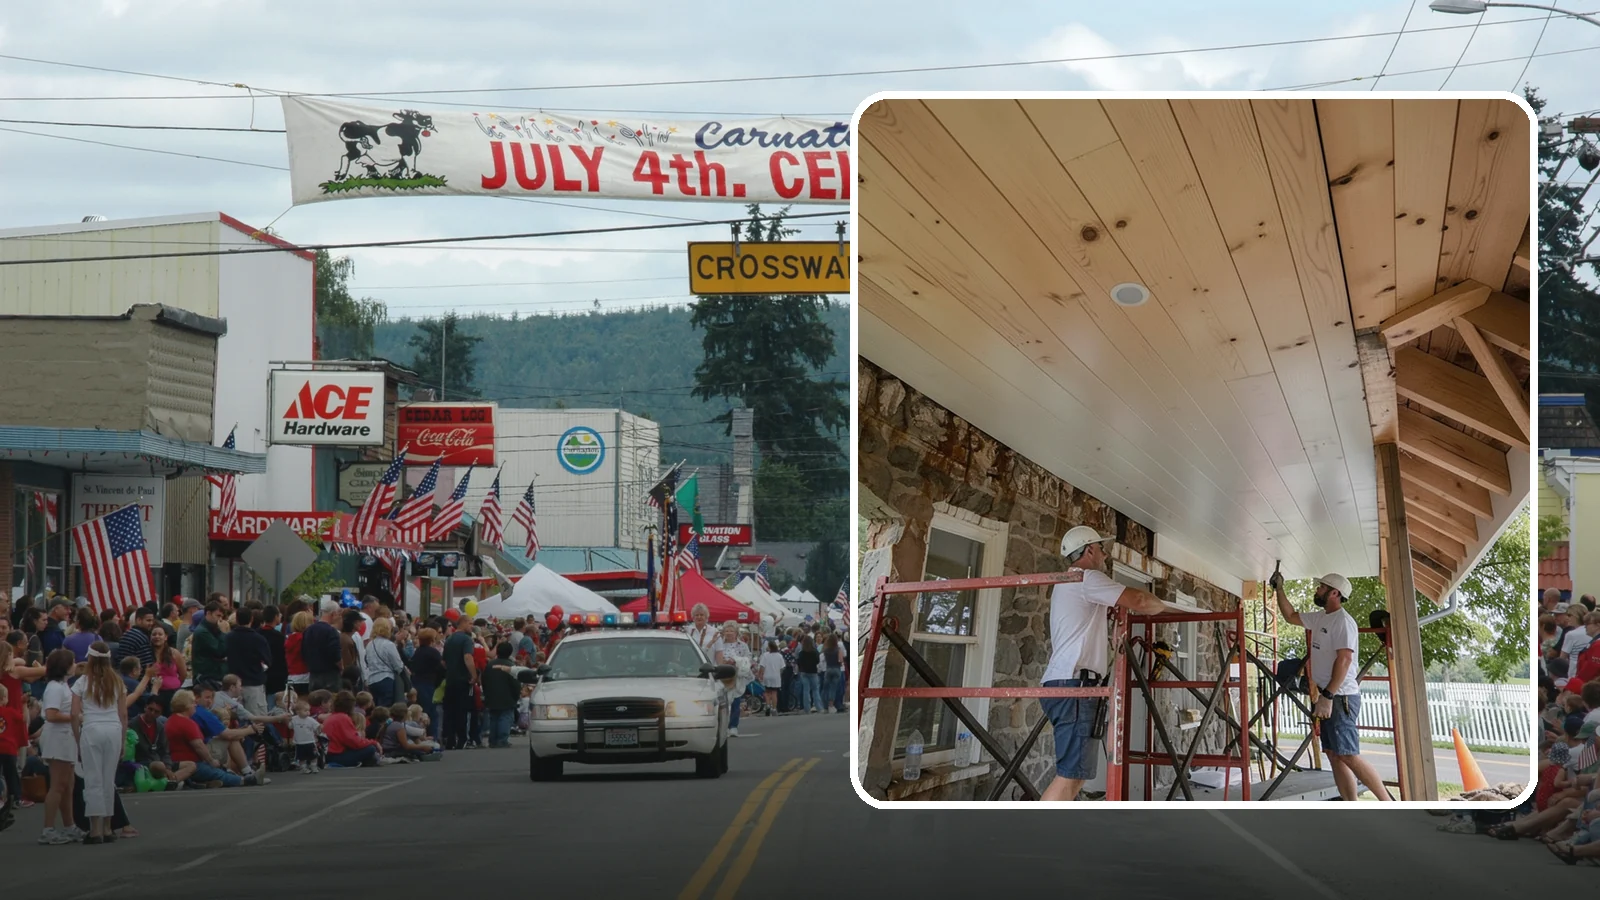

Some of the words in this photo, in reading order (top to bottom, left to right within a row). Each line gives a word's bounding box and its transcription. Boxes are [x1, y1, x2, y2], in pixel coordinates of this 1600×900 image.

[481, 141, 604, 192] JULY
[632, 150, 746, 197] 4th.
[697, 254, 850, 279] CROSSWA
[283, 380, 373, 419] ACE
[406, 409, 452, 421] CEDAR
[461, 409, 485, 421] LOG
[284, 421, 370, 436] Hardware
[354, 467, 384, 481] Simpl
[96, 485, 124, 494] Vincent
[126, 486, 135, 494] de
[138, 486, 155, 495] Paul
[81, 503, 153, 522] THT
[213, 517, 330, 536] HARDARE
[688, 526, 741, 535] CRNATION
[699, 535, 730, 543] GLASS
